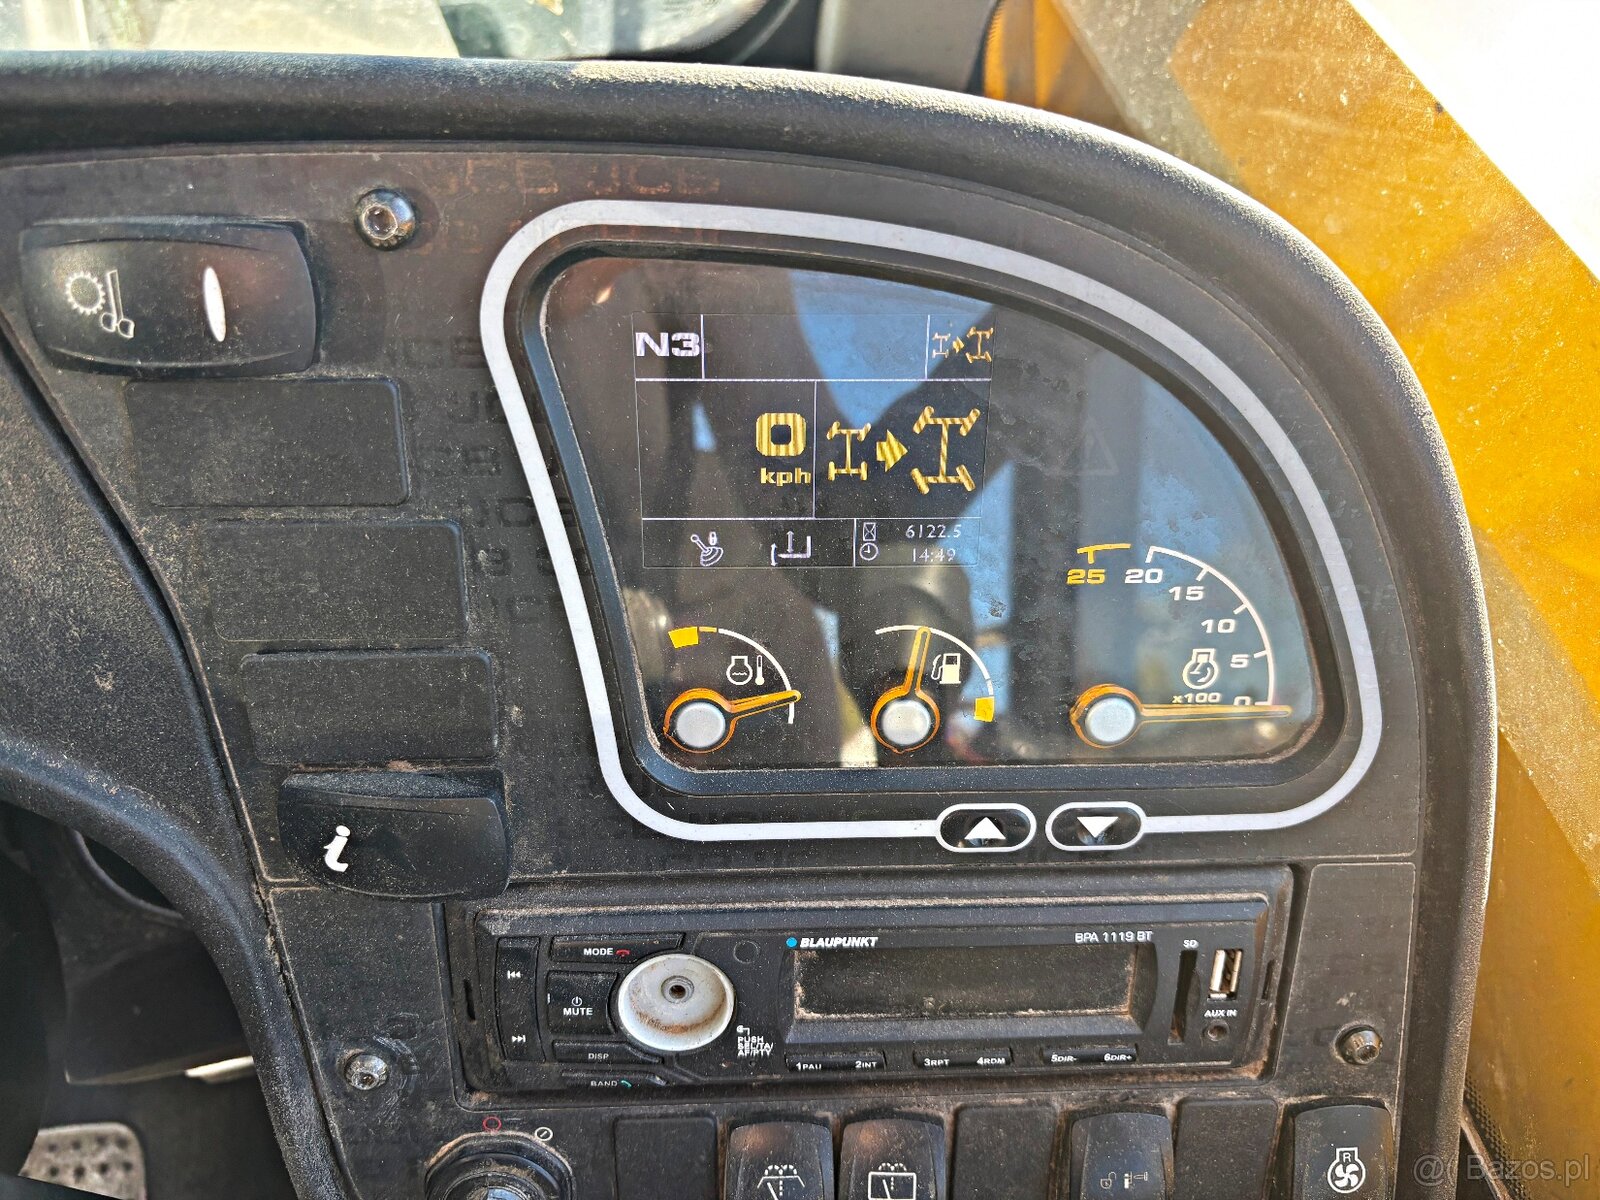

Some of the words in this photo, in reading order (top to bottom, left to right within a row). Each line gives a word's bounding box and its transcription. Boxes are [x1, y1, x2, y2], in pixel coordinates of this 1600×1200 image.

[635, 331, 700, 357] N3
[755, 412, 807, 457] 0
[760, 467, 812, 487] kph
[905, 524, 962, 539] 6122.5
[912, 547, 956, 563] 14:49
[1066, 568, 1106, 585] 25
[1124, 568, 1164, 584] 20
[1168, 585, 1205, 602] 15
[1200, 618, 1236, 634] 10
[1230, 654, 1250, 669] 5
[1172, 692, 1222, 705] x100
[799, 936, 878, 949] BLAUPUNKT
[1074, 931, 1099, 944] BPA
[1102, 931, 1135, 943] 1119
[1137, 930, 1153, 942] BT
[1183, 939, 1199, 950] SD
[583, 947, 614, 957] MODE
[563, 1007, 593, 1017] MUTE
[1204, 1009, 1226, 1018] AUX
[1226, 1009, 1238, 1018] IN
[737, 1035, 764, 1044] PUSH
[588, 1052, 609, 1061] DISP
[590, 1080, 618, 1088] BAND
